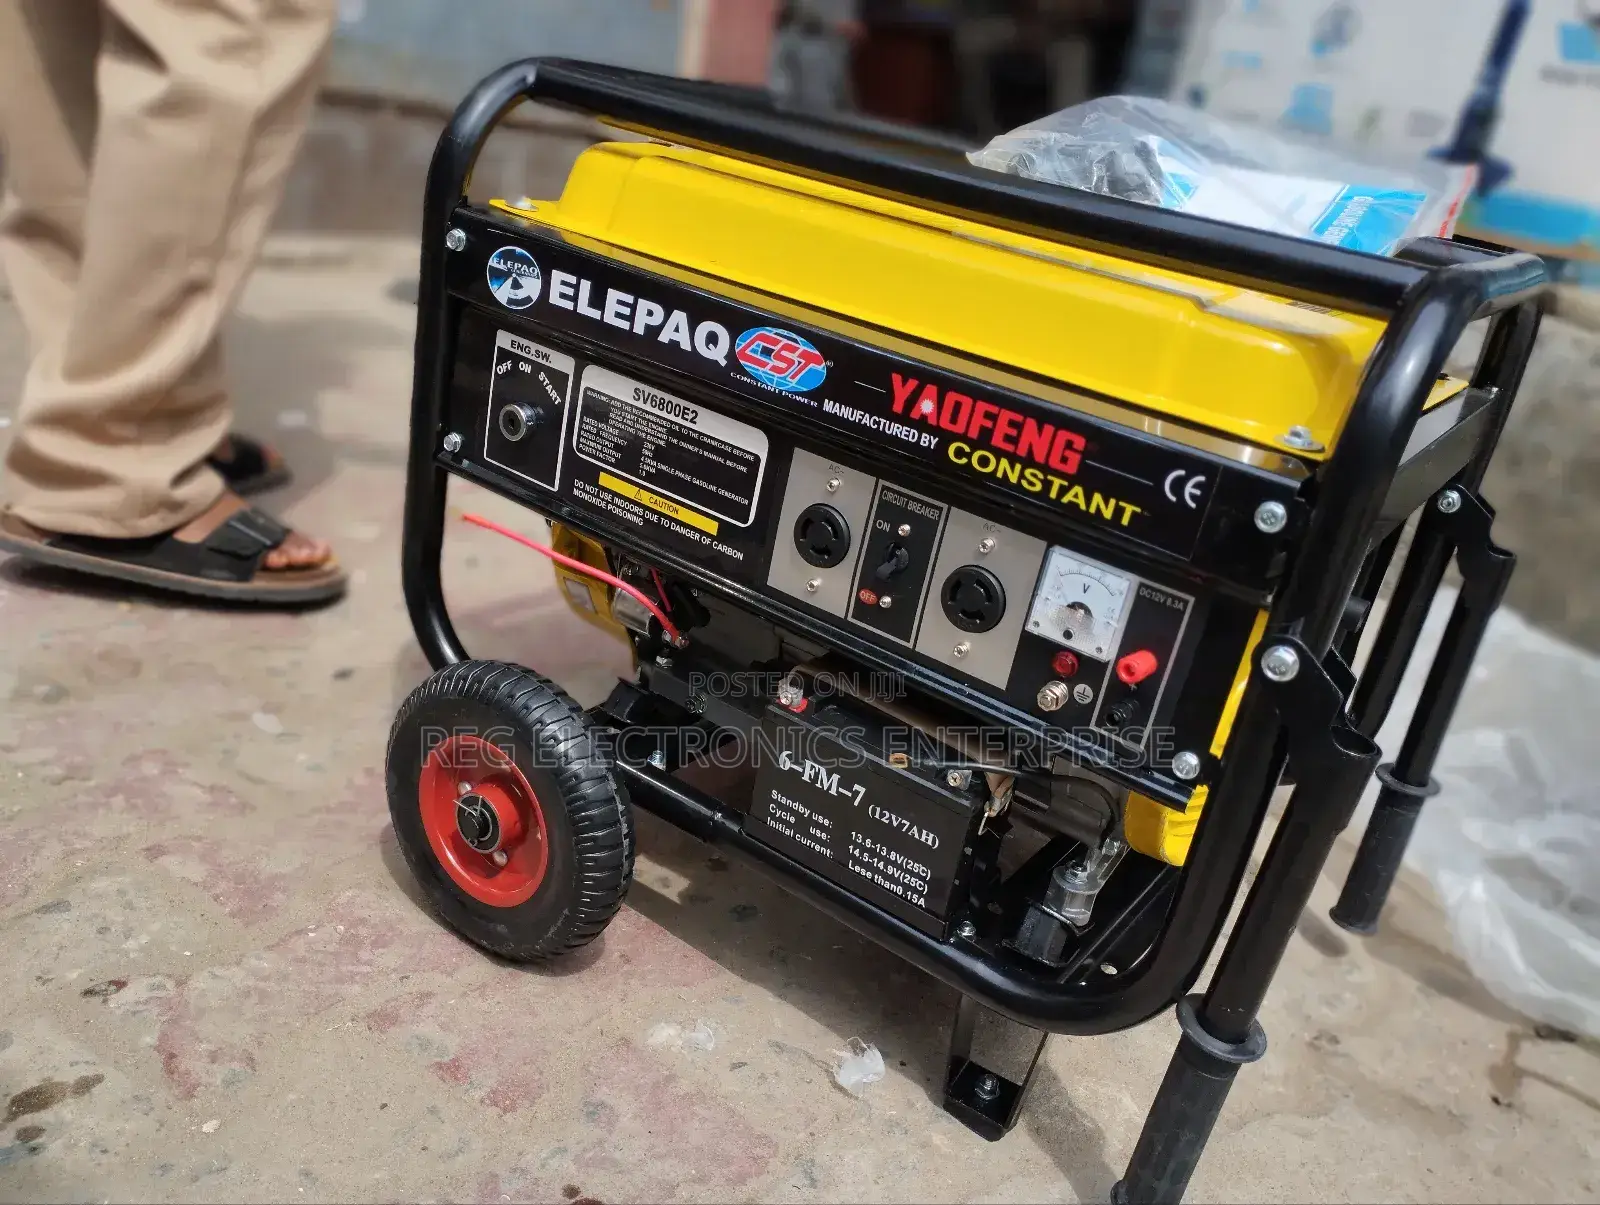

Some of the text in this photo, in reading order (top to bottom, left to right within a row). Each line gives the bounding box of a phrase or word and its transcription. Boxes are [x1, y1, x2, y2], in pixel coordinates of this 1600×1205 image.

[549, 269, 730, 367] ELEPAQ
[496, 360, 512, 375] OFF
[510, 339, 552, 364] ENG.SW.
[519, 361, 532, 374] ON
[736, 331, 826, 382] CST
[538, 371, 562, 405] START
[632, 387, 698, 425] SV6800E2
[730, 372, 818, 408] CONSTANT POWER
[582, 423, 597, 434] RATED
[599, 430, 628, 447] FREQUENCY
[583, 415, 598, 427] RATED
[598, 422, 619, 436] VOLTAGE
[608, 418, 636, 434] OPERATING
[636, 430, 646, 439] THE
[621, 410, 638, 422] START
[638, 417, 648, 427] THE
[622, 403, 632, 412] THE
[632, 406, 671, 428] RECOMMENDED
[671, 423, 680, 432] OIL
[681, 427, 688, 435] TO
[688, 430, 699, 439] THE
[699, 435, 732, 453] CRANKCASE
[732, 448, 754, 462] BEFORE
[822, 398, 939, 450] MANUFACTURED BY
[890, 372, 1087, 475] YAOFENG
[578, 443, 596, 456] POWER
[596, 451, 616, 464] FACTOR
[602, 446, 622, 459] OUTPUT
[609, 412, 623, 422] READ
[623, 418, 634, 427] AND
[634, 422, 668, 440] UNDERSTAND
[668, 435, 679, 445] THE
[703, 450, 725, 465] MANUAL
[580, 430, 596, 441] RATED
[595, 437, 615, 449] OUTPUT
[657, 462, 675, 475] SINGLE
[674, 470, 692, 482] PHASE
[692, 477, 717, 493] GASOLINE
[717, 488, 749, 506] GENERATOR
[947, 442, 1141, 527] CONSTANT
[572, 488, 644, 526] MONOXIDE POISONING
[648, 495, 680, 515] CAUTION
[881, 489, 940, 521] CIRCUIT BREAKER
[1164, 469, 1206, 509] CE
[574, 478, 744, 561] DO NOT USE INDOORS DUE TO DANGER OF CARBON
[876, 519, 891, 533] ON
[859, 590, 876, 604] OFF
[1083, 582, 1091, 594] V
[1139, 587, 1165, 604] DC12V
[771, 789, 811, 818] Standby
[811, 810, 833, 829] use:
[779, 750, 940, 850] 6-FM-7 (12V7AH)
[767, 816, 794, 838] Initial
[795, 831, 834, 860] current:
[769, 803, 796, 824] Cycle
[809, 825, 831, 843] use:
